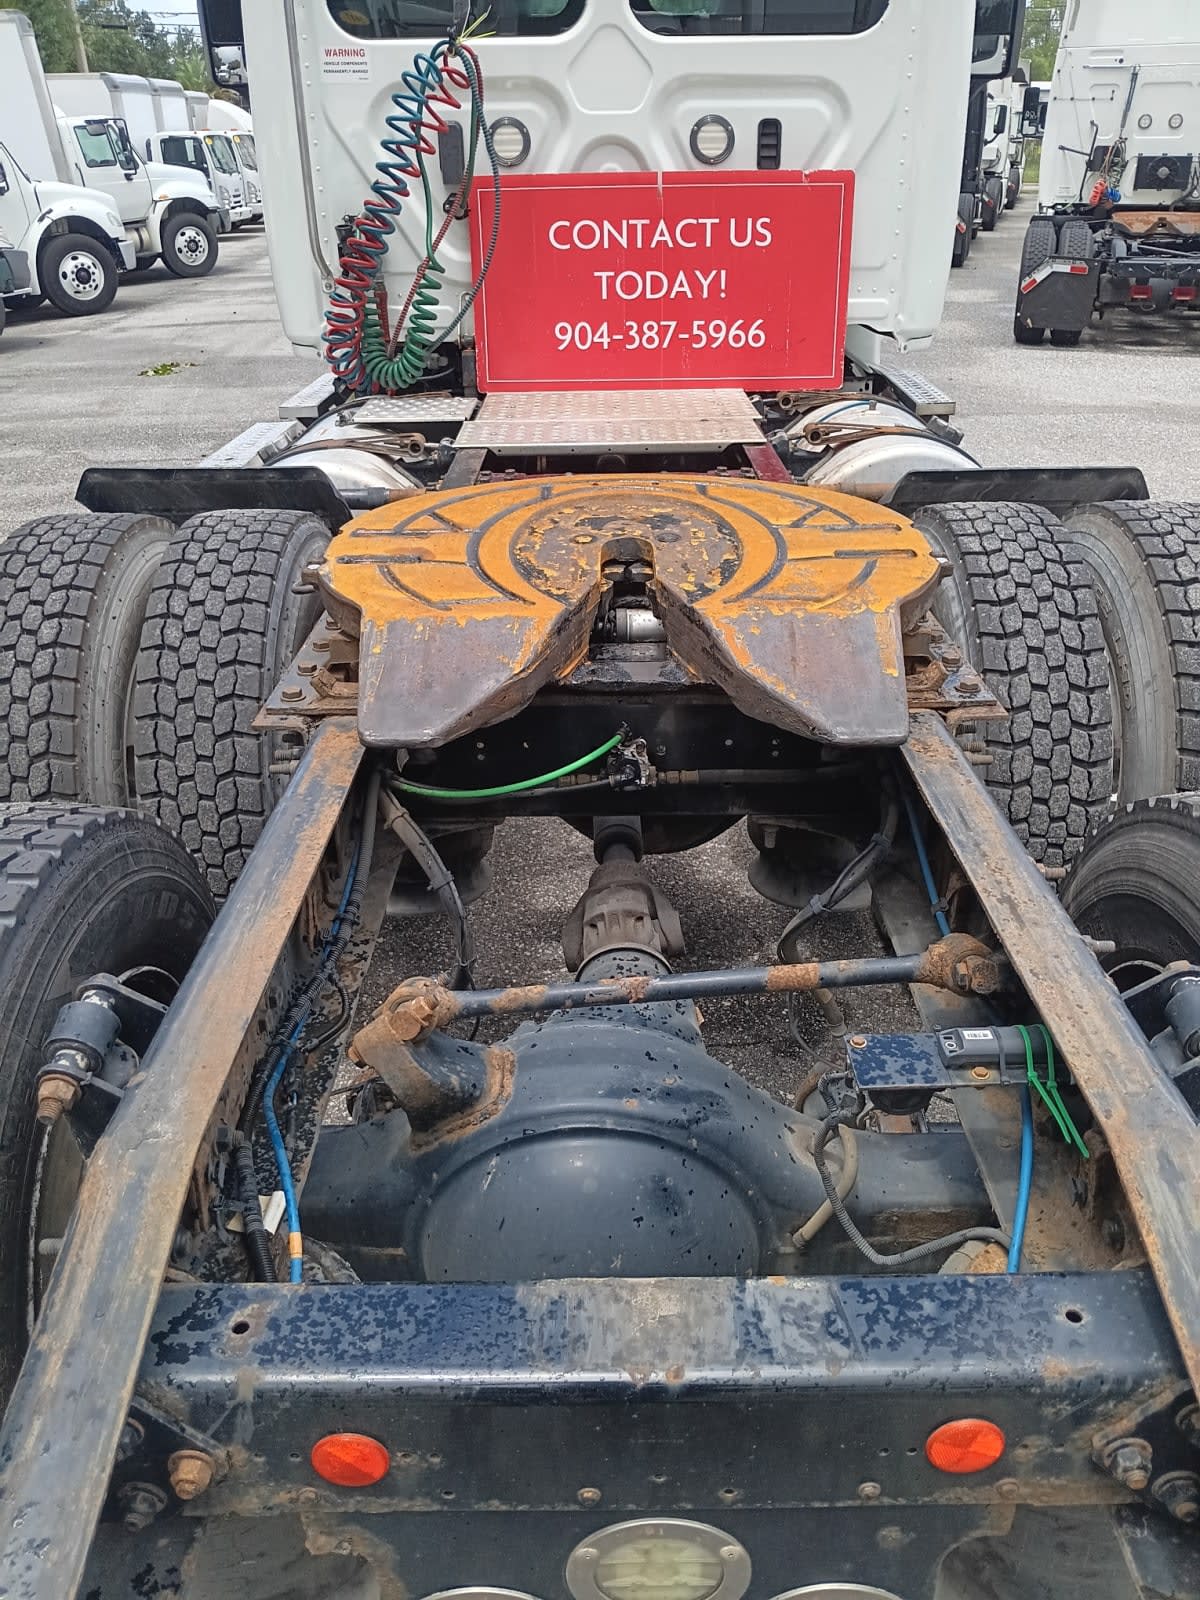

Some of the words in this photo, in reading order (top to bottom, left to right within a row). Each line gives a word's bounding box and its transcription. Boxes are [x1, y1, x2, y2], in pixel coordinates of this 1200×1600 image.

[324, 48, 366, 58] WARNING
[548, 218, 720, 250] CONTACT
[729, 217, 772, 248] US
[593, 270, 727, 301] TODAY!
[554, 318, 767, 351] 904-387-5966
